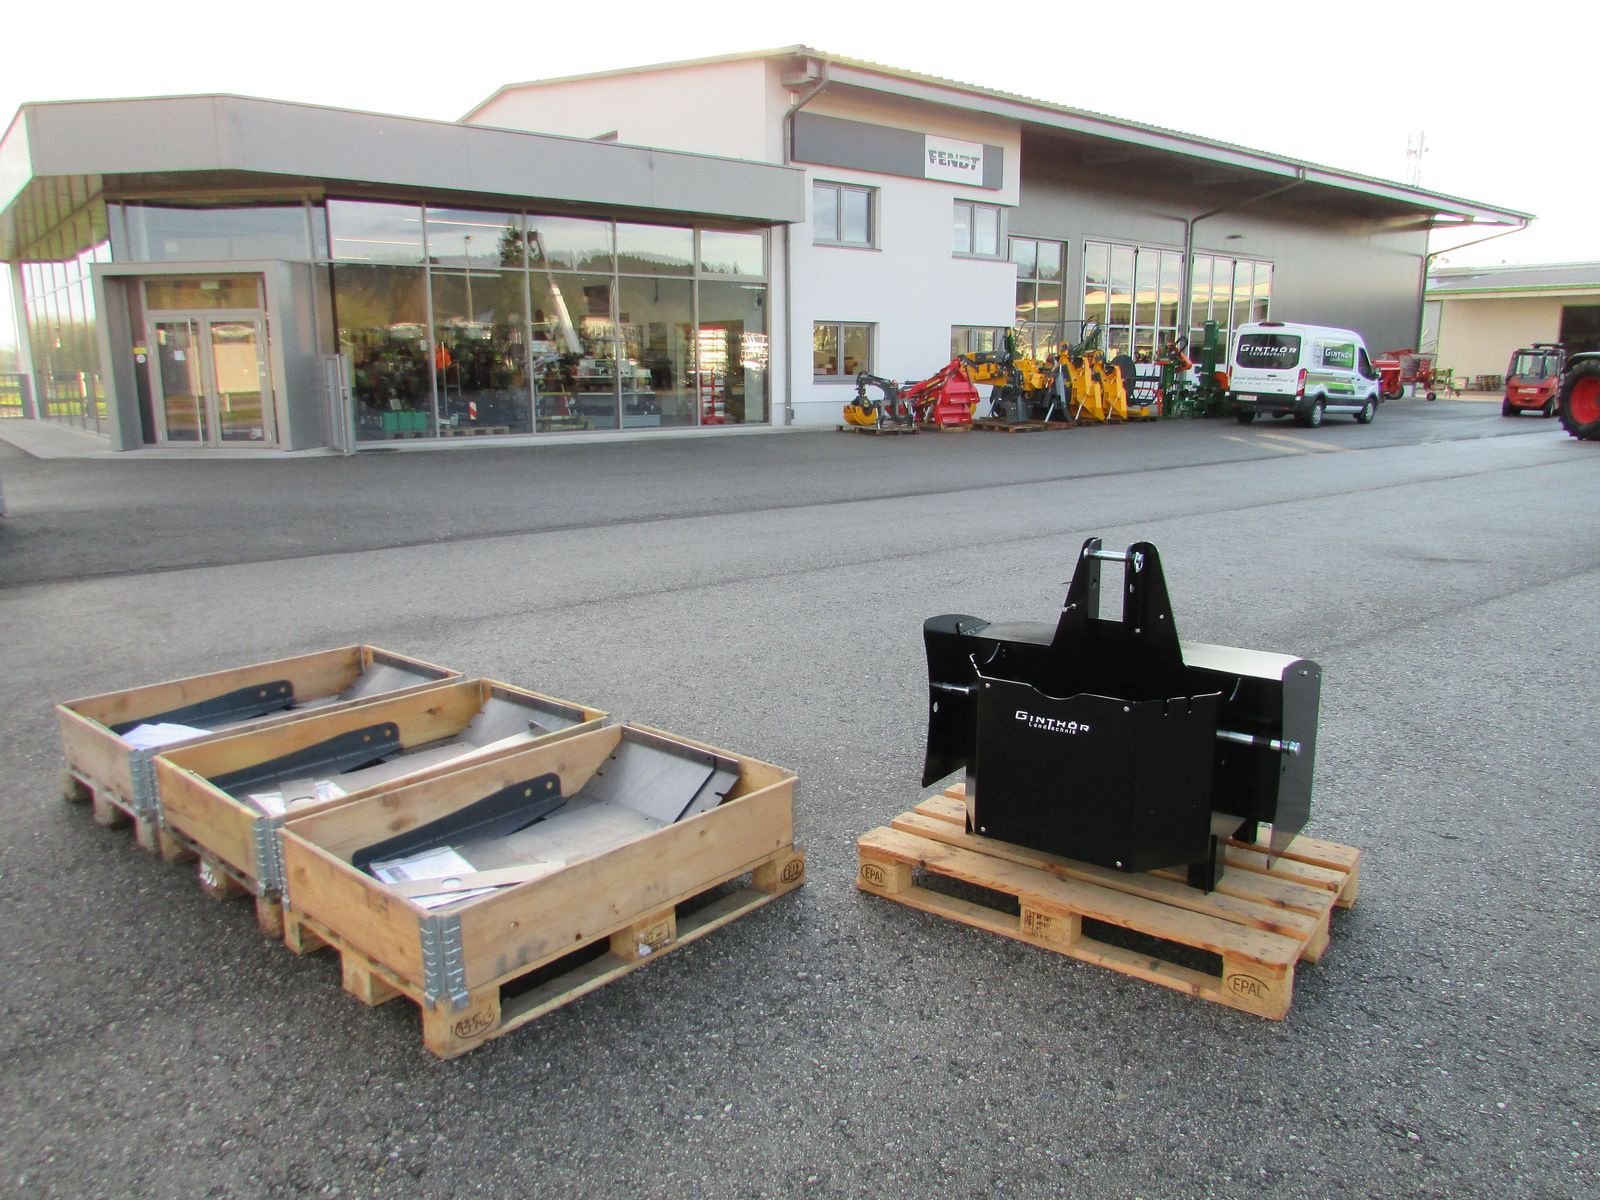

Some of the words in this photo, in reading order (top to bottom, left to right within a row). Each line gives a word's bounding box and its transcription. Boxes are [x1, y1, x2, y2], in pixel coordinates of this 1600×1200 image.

[928, 149, 980, 170] FENDT
[1015, 710, 1090, 732] GINTHÖR
[1233, 977, 1265, 999] EPAL
